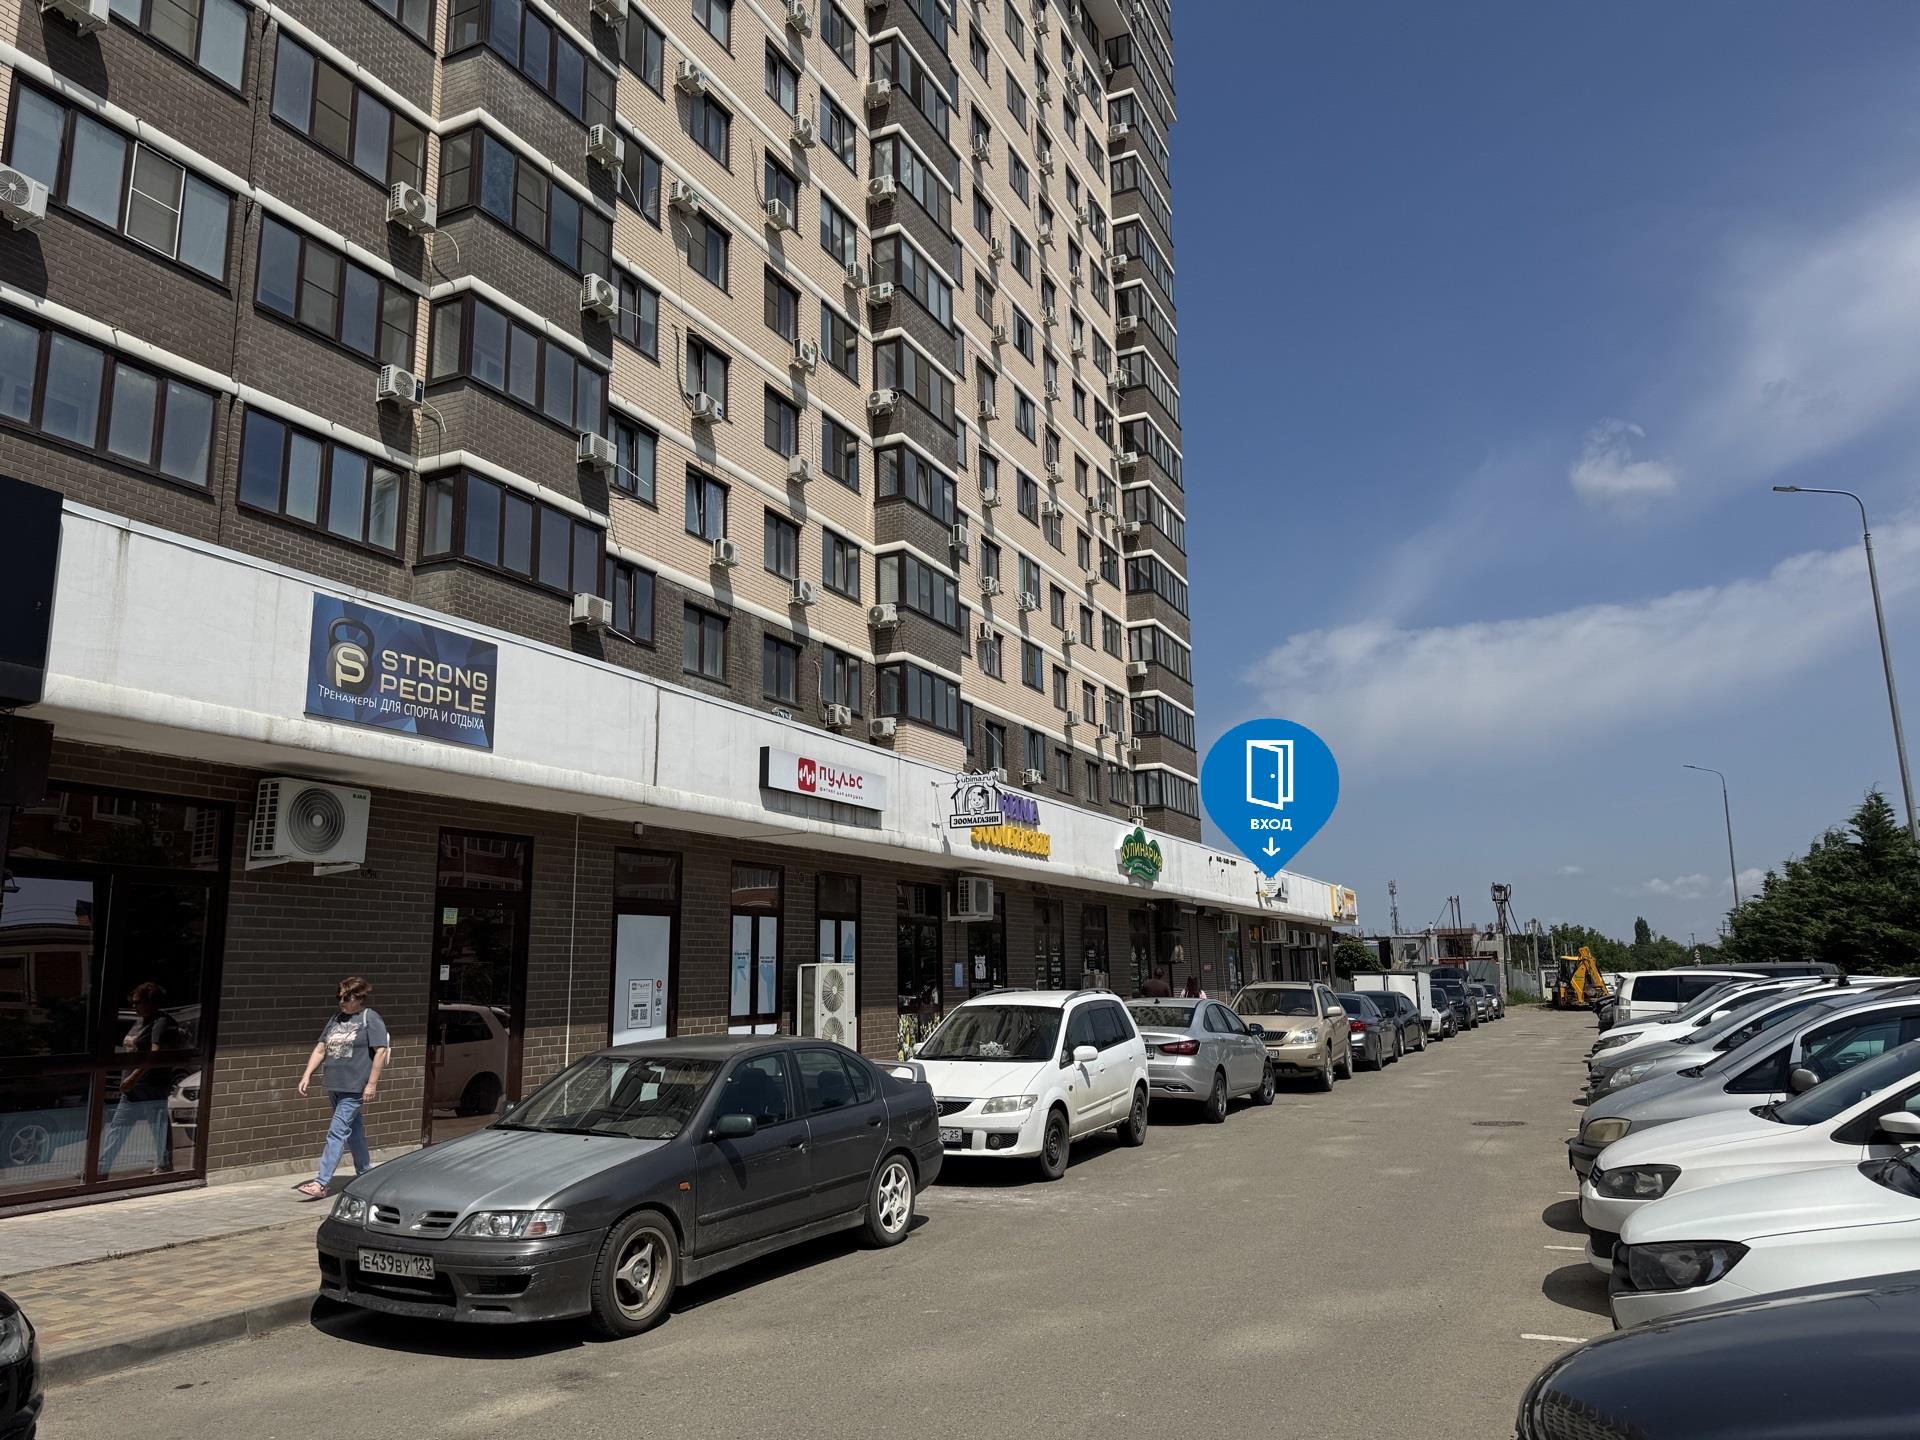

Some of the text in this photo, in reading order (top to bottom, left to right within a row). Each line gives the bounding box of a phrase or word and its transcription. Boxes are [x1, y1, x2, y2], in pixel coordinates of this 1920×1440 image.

[382, 649, 488, 692] STRONG
[318, 684, 485, 730] ТРЕНАЖЕРЫ ДЛЯ СПОРТА И ОТДЫХА
[380, 673, 487, 714] PEOPLE
[953, 815, 999, 825] ЗООМАГАЗИН
[413, 1256, 431, 1271] 123
